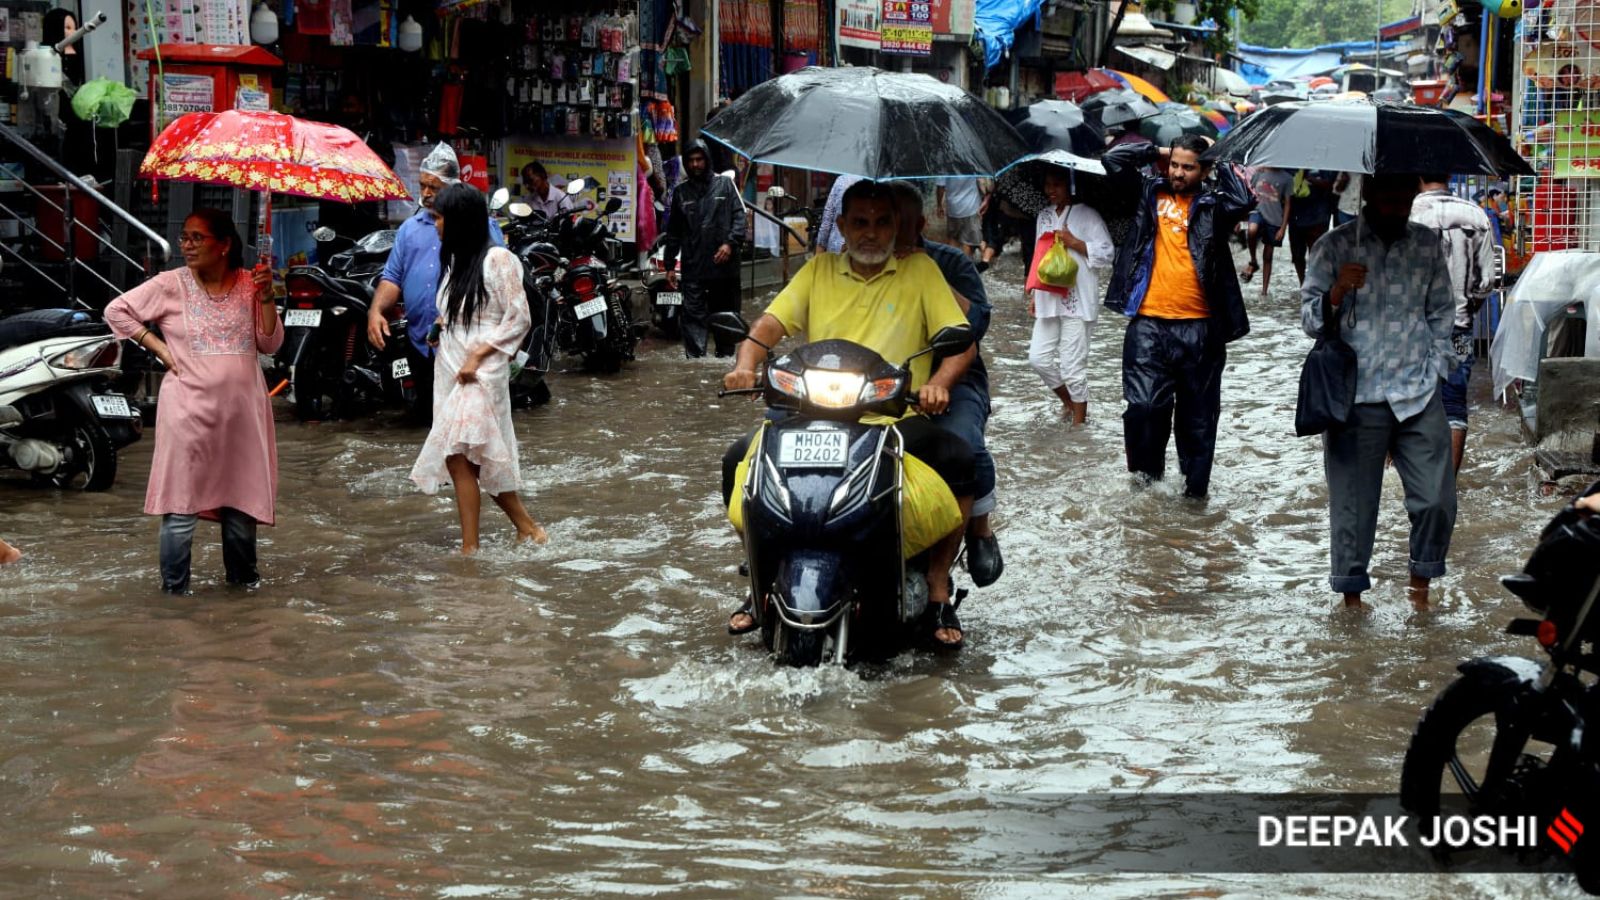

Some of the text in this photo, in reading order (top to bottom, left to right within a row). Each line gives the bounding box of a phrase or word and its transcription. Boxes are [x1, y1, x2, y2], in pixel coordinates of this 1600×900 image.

[911, 3, 929, 12] 96
[795, 433, 842, 447] MH04N
[794, 448, 841, 461] D2402
